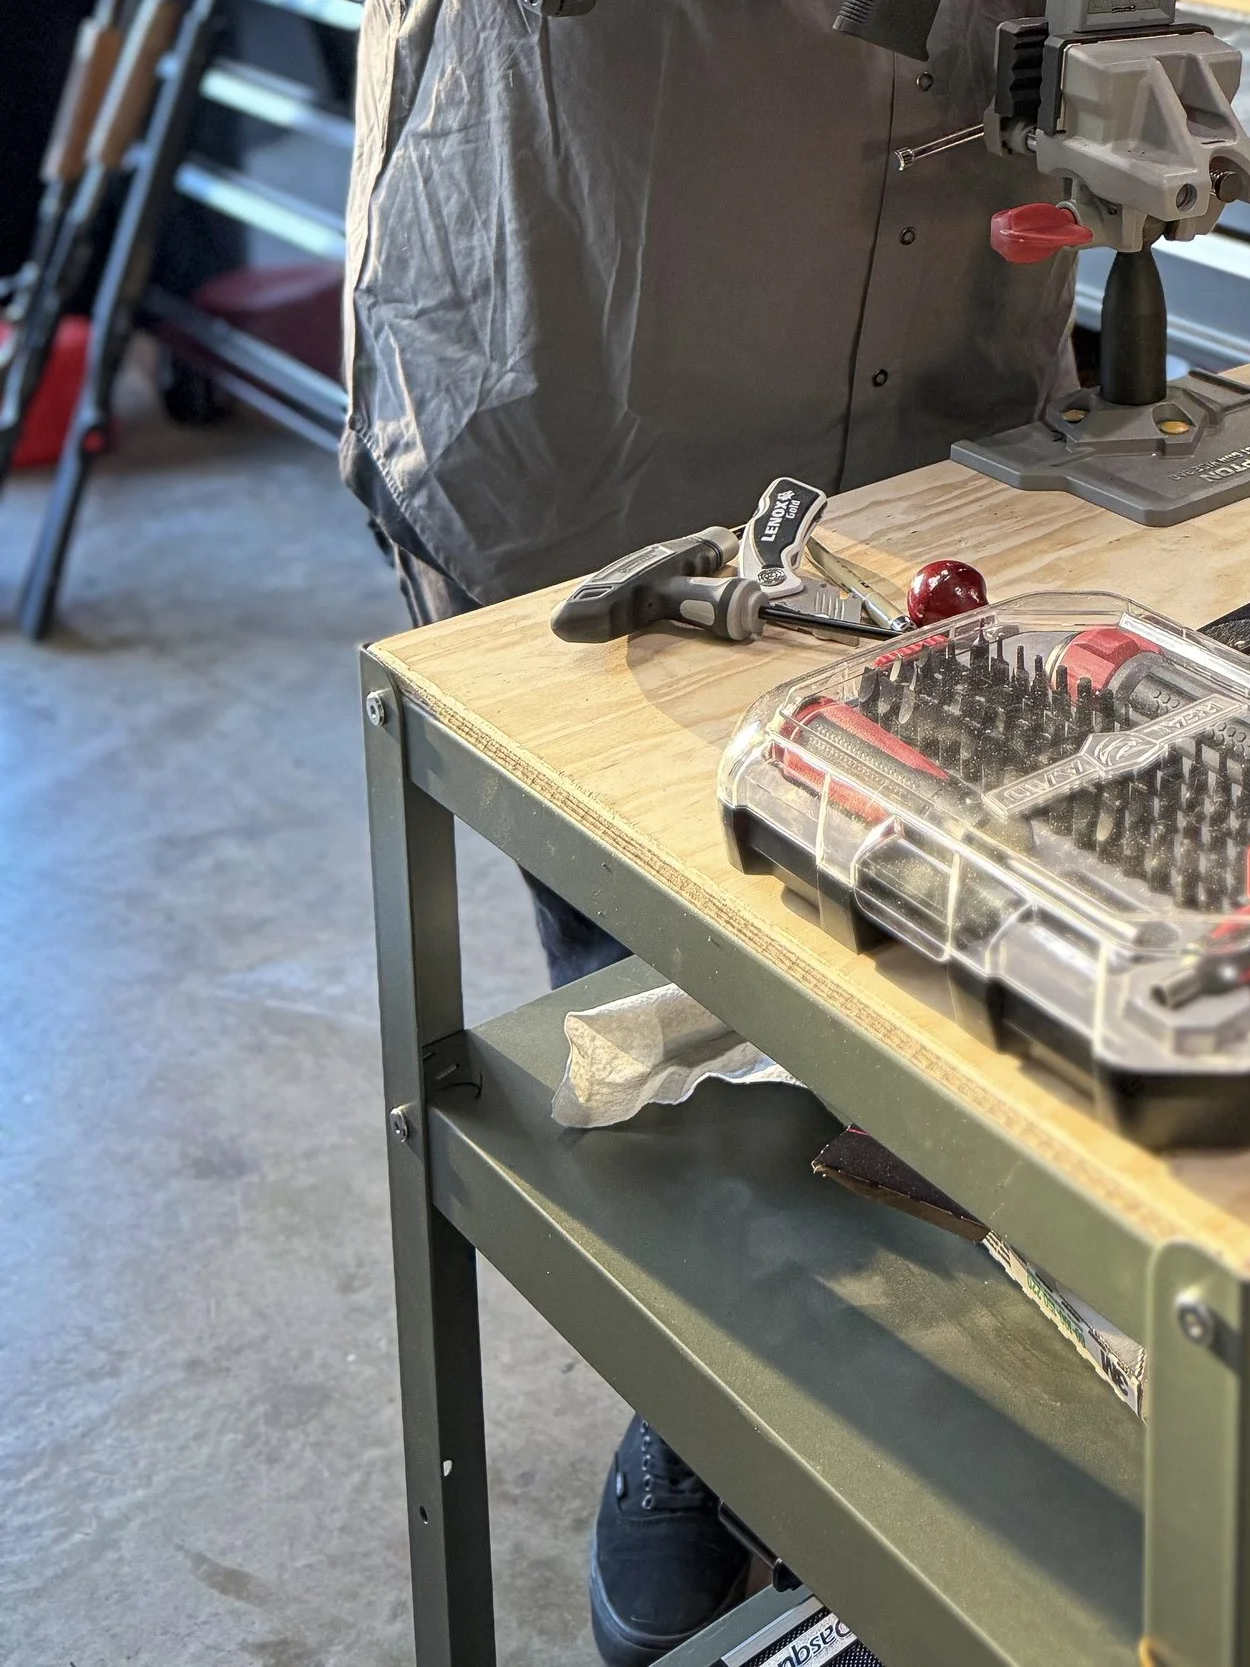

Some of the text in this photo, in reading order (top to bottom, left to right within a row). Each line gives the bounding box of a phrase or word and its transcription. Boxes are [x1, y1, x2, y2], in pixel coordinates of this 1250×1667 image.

[761, 500, 789, 542] LENOX
[786, 499, 801, 519] Gold
[1099, 1350, 1130, 1398] 3M
